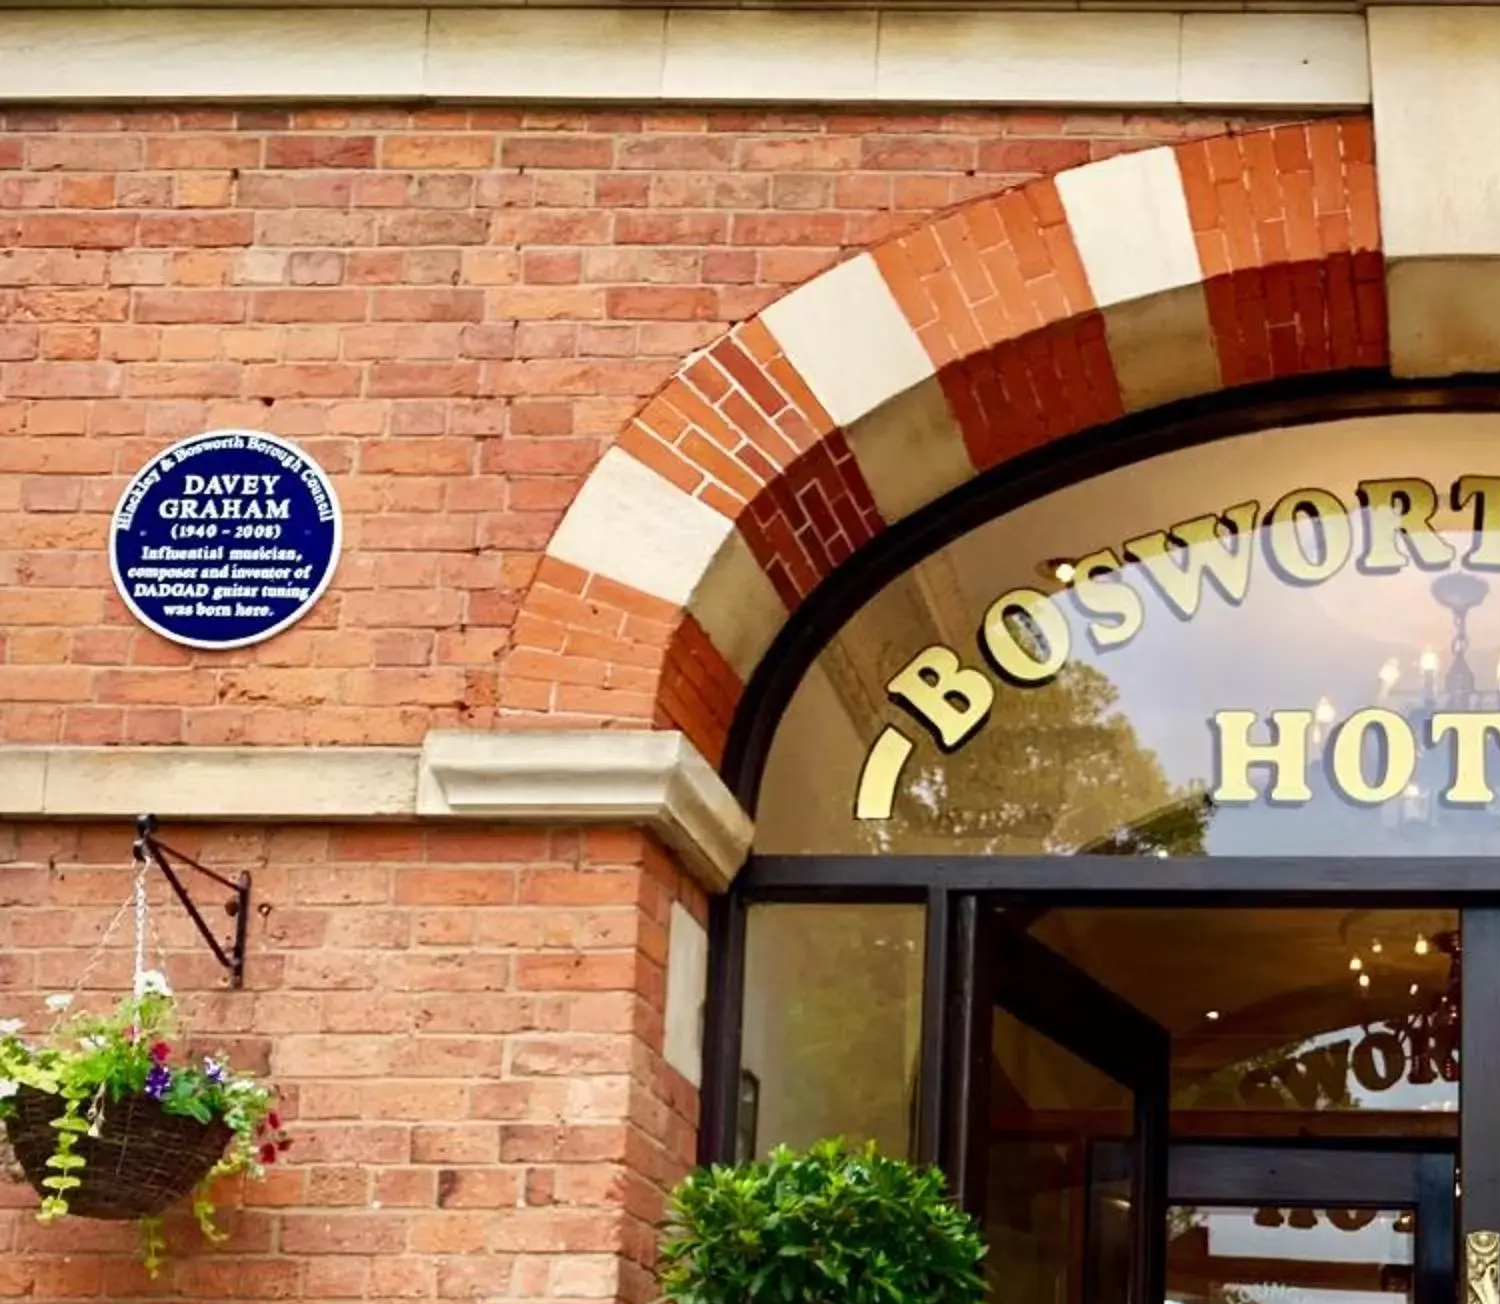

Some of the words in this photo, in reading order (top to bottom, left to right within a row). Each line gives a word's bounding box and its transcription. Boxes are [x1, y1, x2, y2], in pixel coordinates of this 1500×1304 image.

[116, 468, 161, 531] Hinckley
[160, 458, 177, 473] &
[172, 436, 245, 463] Bosworth
[246, 437, 303, 473] Borough
[301, 469, 334, 522] Council
[183, 475, 281, 495] DAVEY
[159, 498, 291, 519] GRAHAM
[170, 523, 218, 540] (1940
[234, 523, 282, 540] 2008)
[141, 545, 225, 561] Influential
[229, 546, 303, 562] musician,
[127, 567, 198, 582] composer
[200, 564, 229, 580] and
[231, 564, 291, 580] inventor
[294, 565, 313, 580] of
[133, 583, 210, 598] DADGAD
[212, 582, 259, 601] guitar
[261, 581, 310, 602] tuning
[163, 605, 193, 616] was
[195, 602, 231, 617] born
[234, 602, 275, 617] here.
